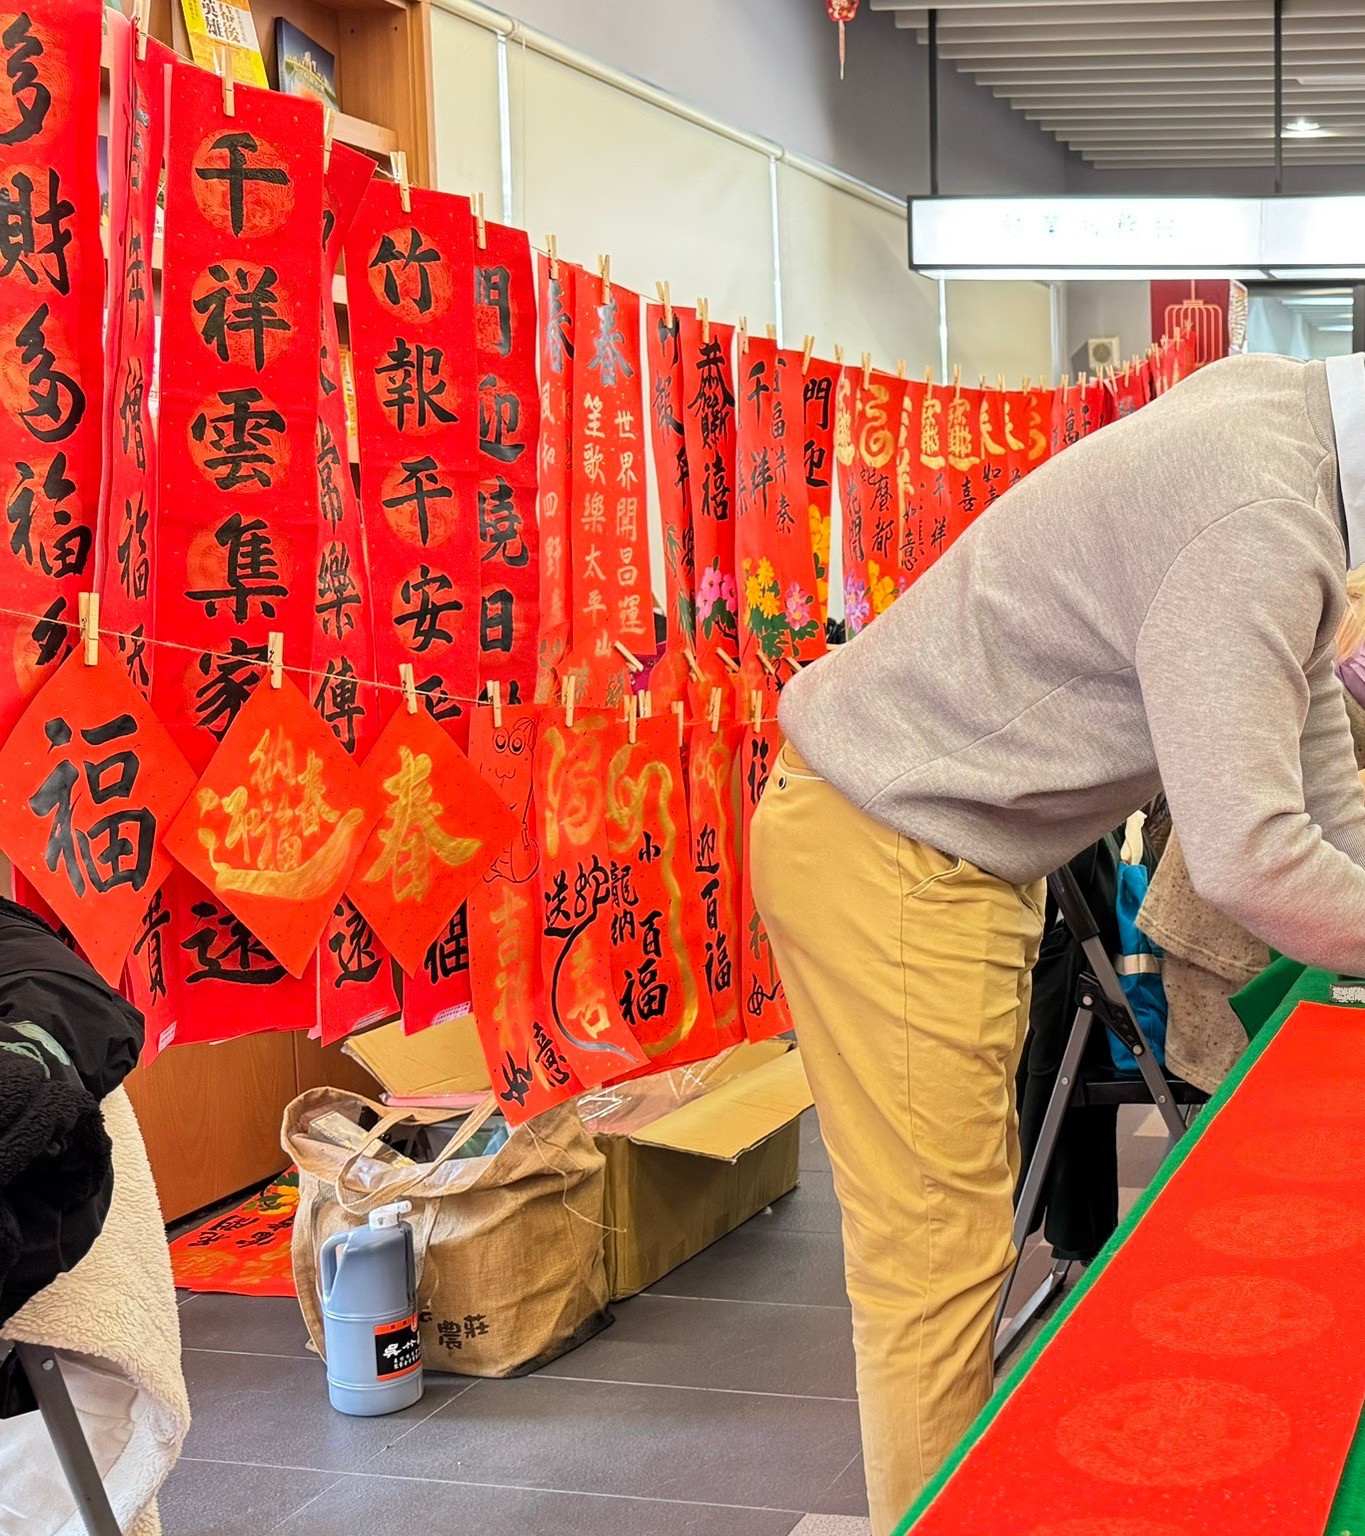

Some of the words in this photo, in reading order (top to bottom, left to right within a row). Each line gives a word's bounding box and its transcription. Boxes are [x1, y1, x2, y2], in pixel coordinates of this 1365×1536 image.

[586, 300, 634, 387] 春
[581, 393, 608, 625] 笙歌樂太平
[614, 409, 646, 636] 世界開昌運
[29, 713, 156, 898] 福
[361, 745, 485, 904] 春
